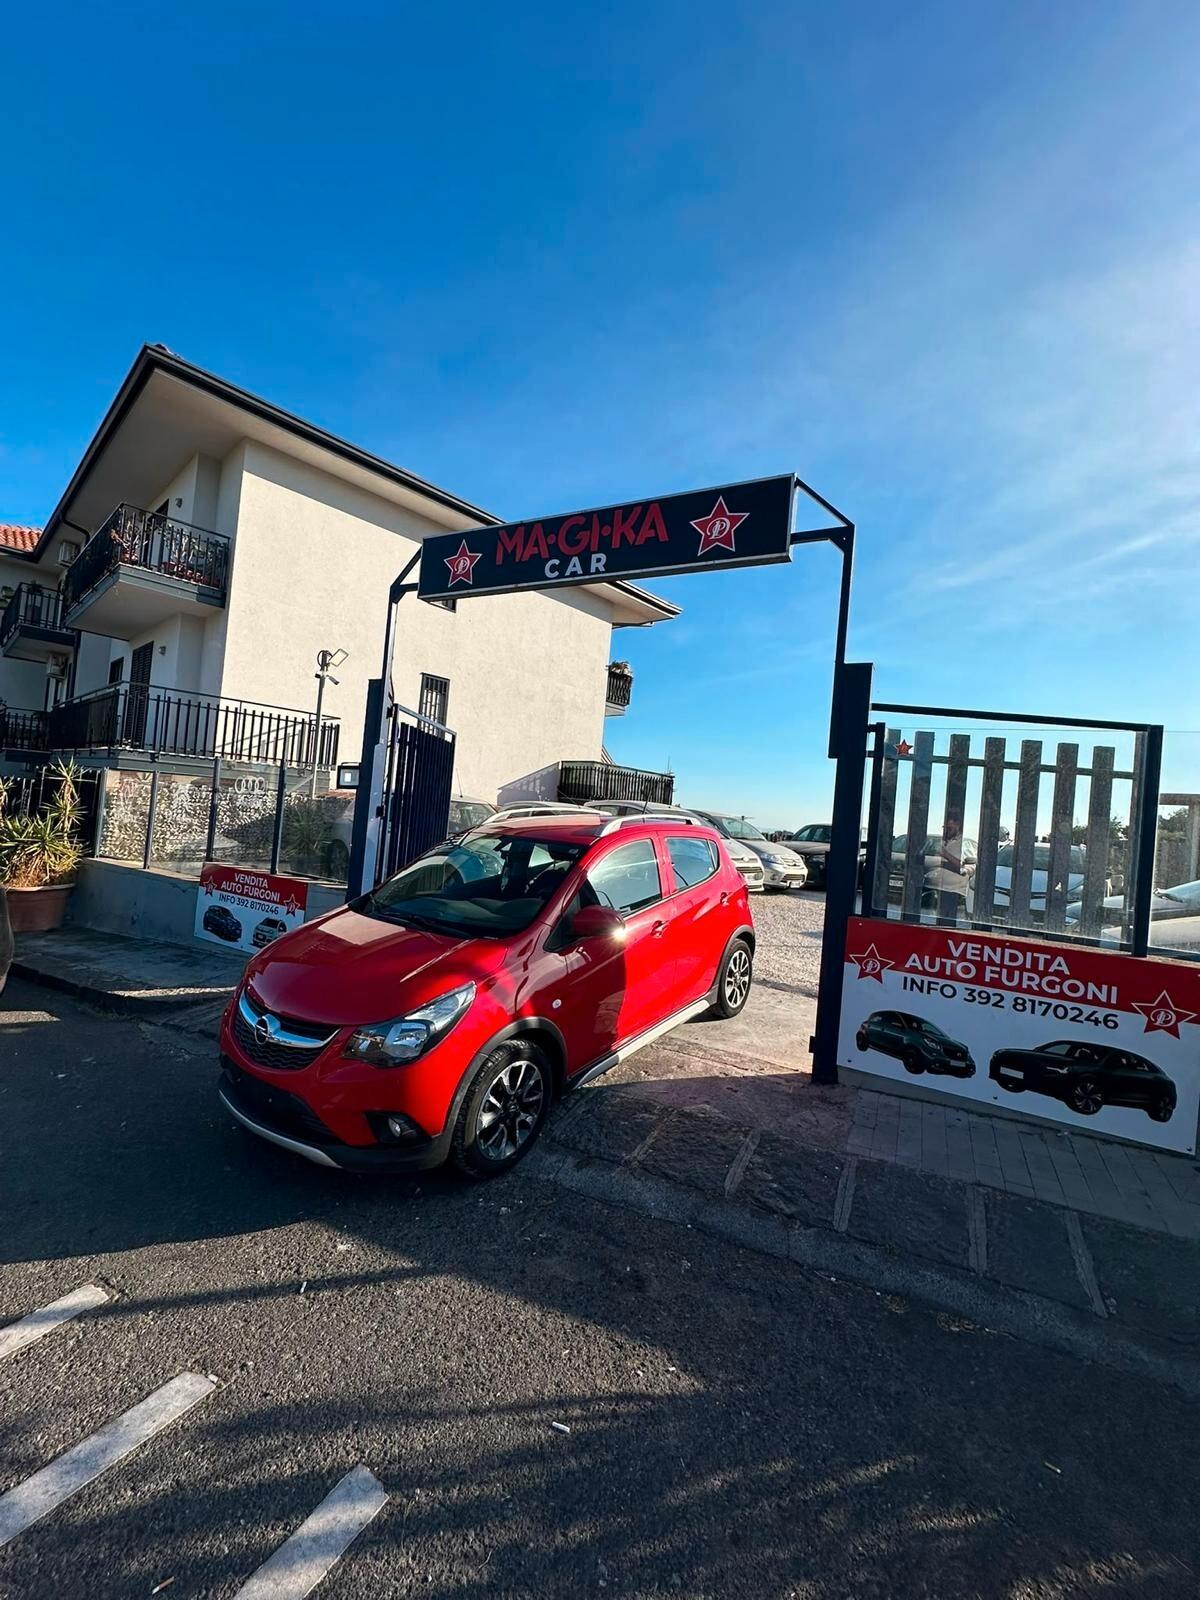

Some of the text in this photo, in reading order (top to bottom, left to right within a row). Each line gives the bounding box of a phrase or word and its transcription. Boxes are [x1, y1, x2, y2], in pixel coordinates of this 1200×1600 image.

[545, 553, 608, 578] CAR
[220, 881, 243, 893] AUTO
[243, 885, 281, 902] FURGONI
[234, 872, 269, 889] VENDITA
[219, 893, 236, 904] INFO
[236, 897, 249, 908] 392
[250, 901, 279, 915] 8170246
[947, 940, 1070, 975] VENDITA
[904, 952, 1118, 1004] AUTO FURGONI
[902, 975, 1120, 1030] INFO 392 8170246
